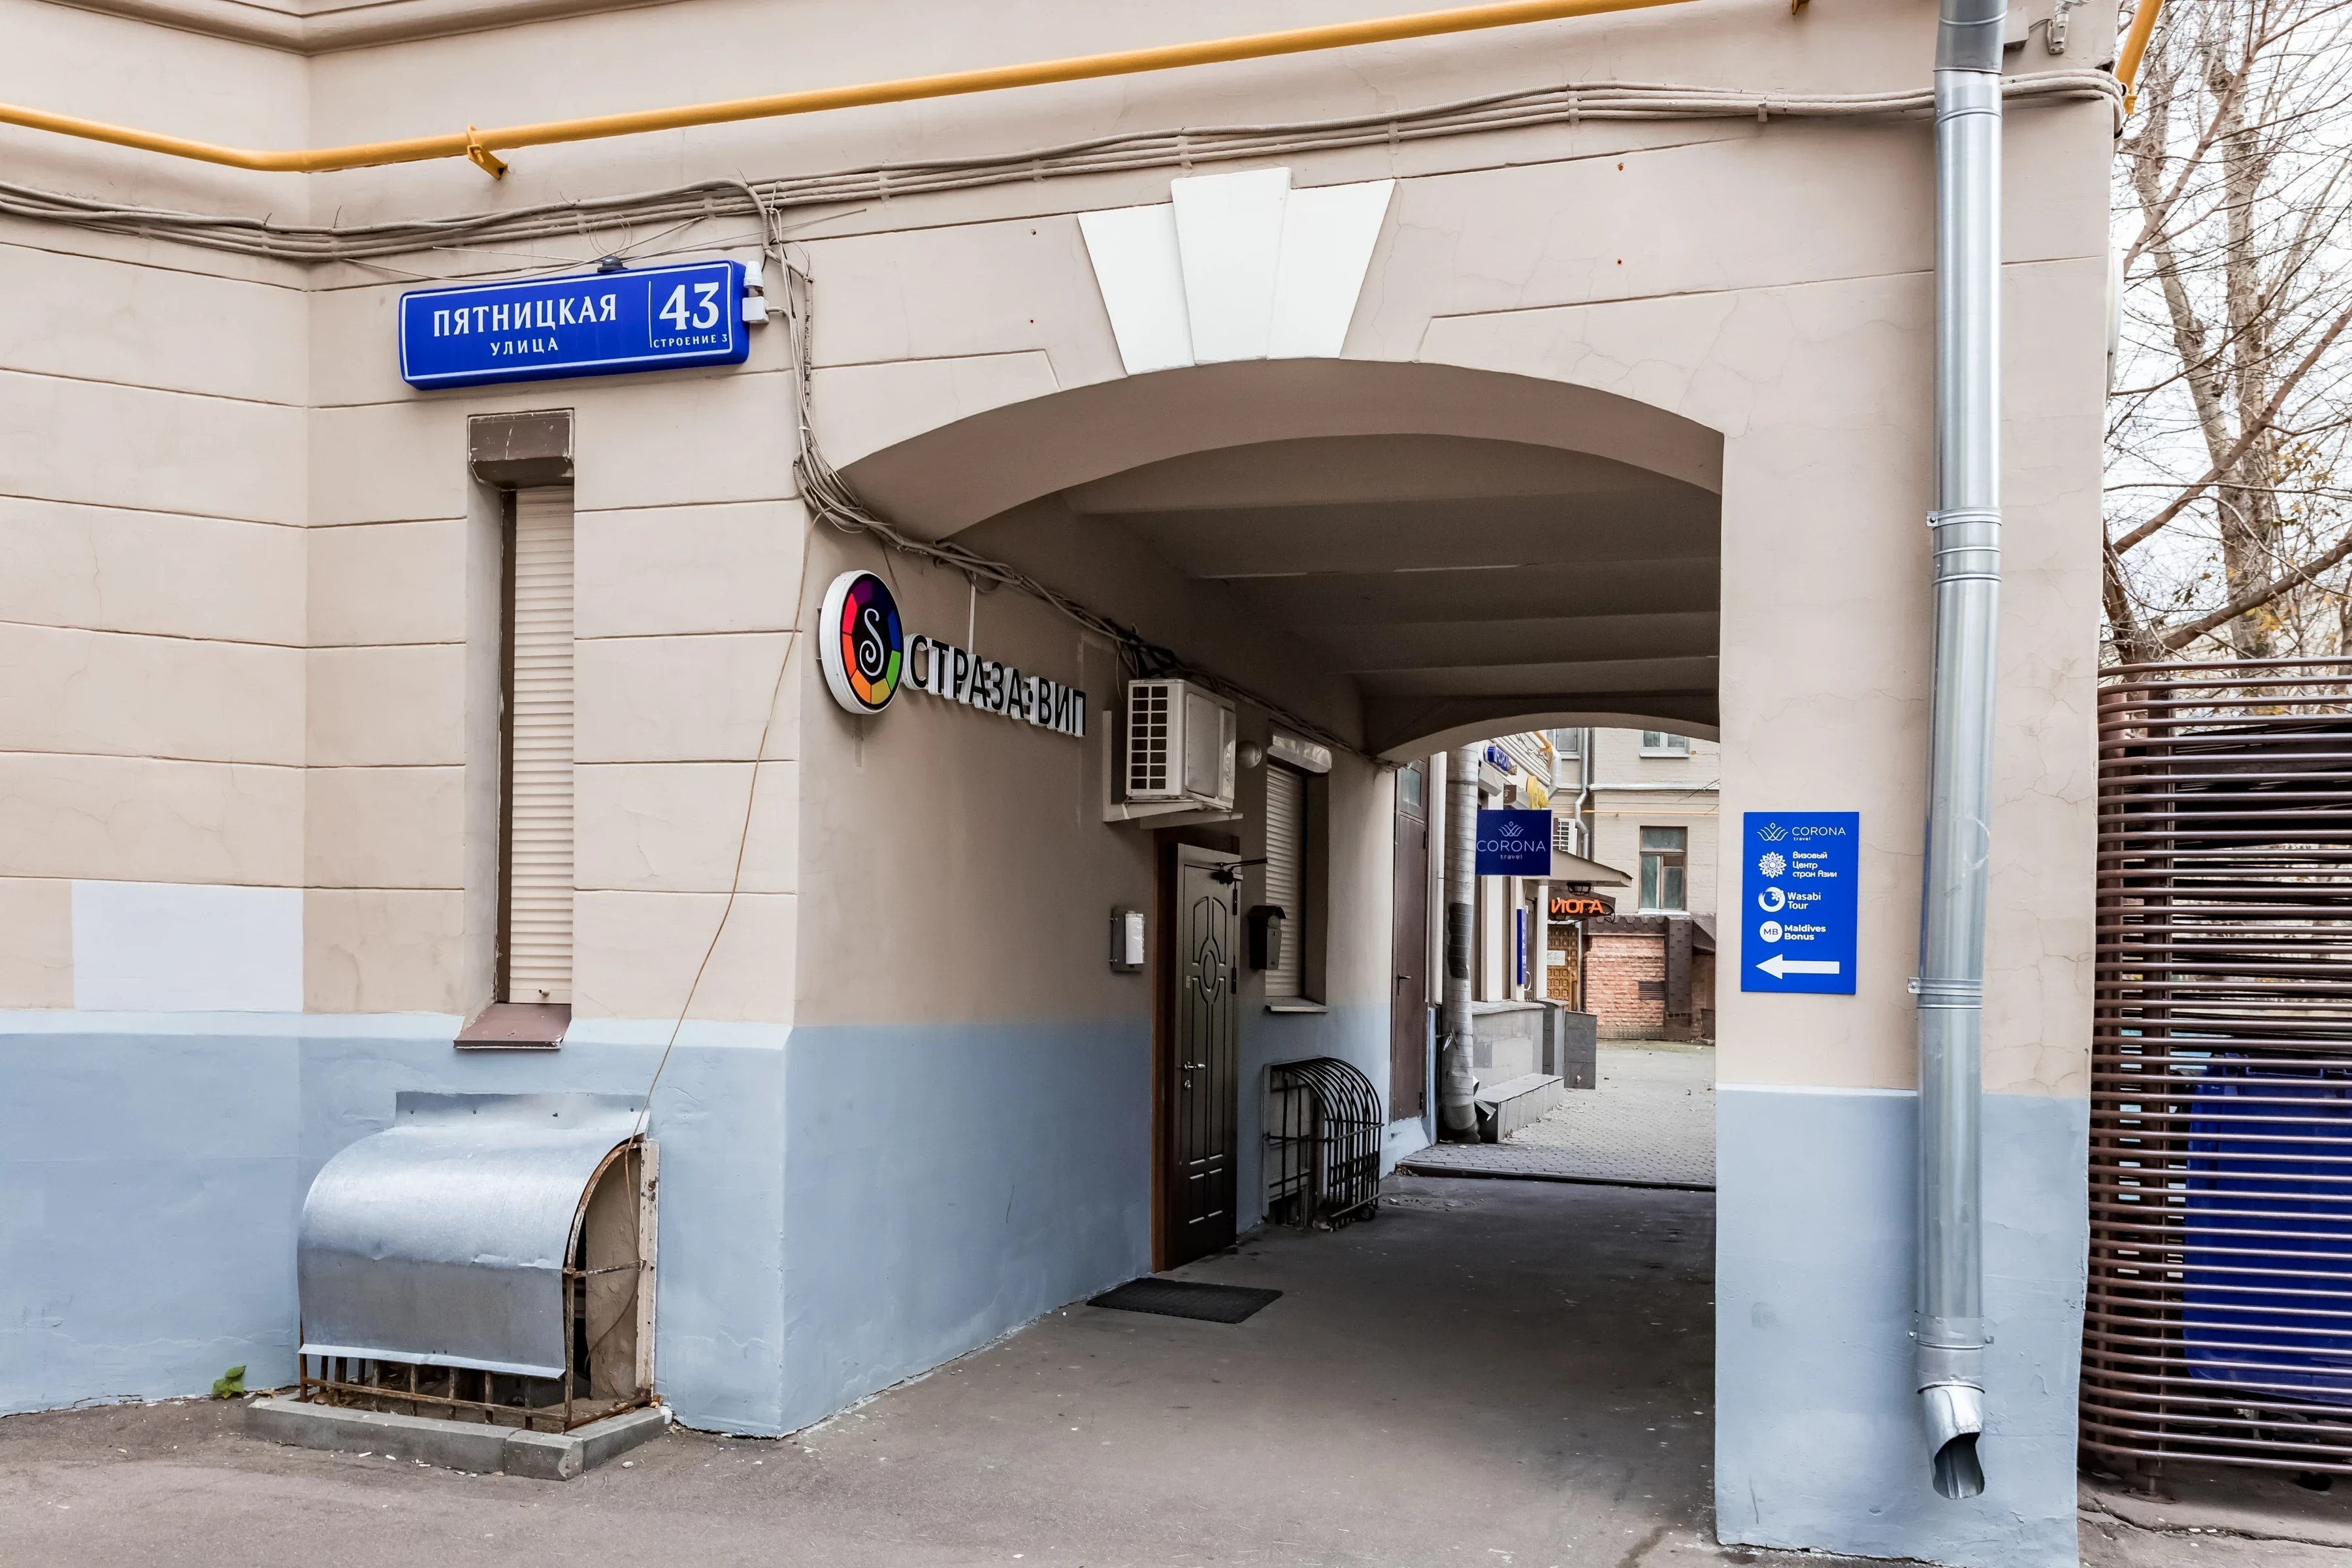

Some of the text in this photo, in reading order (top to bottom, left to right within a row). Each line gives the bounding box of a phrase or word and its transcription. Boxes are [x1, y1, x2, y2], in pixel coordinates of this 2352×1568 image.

[659, 281, 720, 331] 43
[433, 293, 617, 338] ПЯТНИЦКАЯ
[653, 333, 728, 348] СТРОЕНИЕ 3
[490, 337, 559, 357] УЛИЦА
[1791, 826, 1846, 836] CORONA
[1476, 840, 1546, 852] CORONA
[1792, 851, 1828, 859] Визовый
[1792, 860, 1818, 871] Центр
[1792, 871, 1816, 879] стран
[1788, 892, 1821, 901] Wasabi
[1788, 901, 1809, 910] Tour
[1784, 924, 1827, 932] Maldives
[1784, 932, 1815, 941] Bonus
